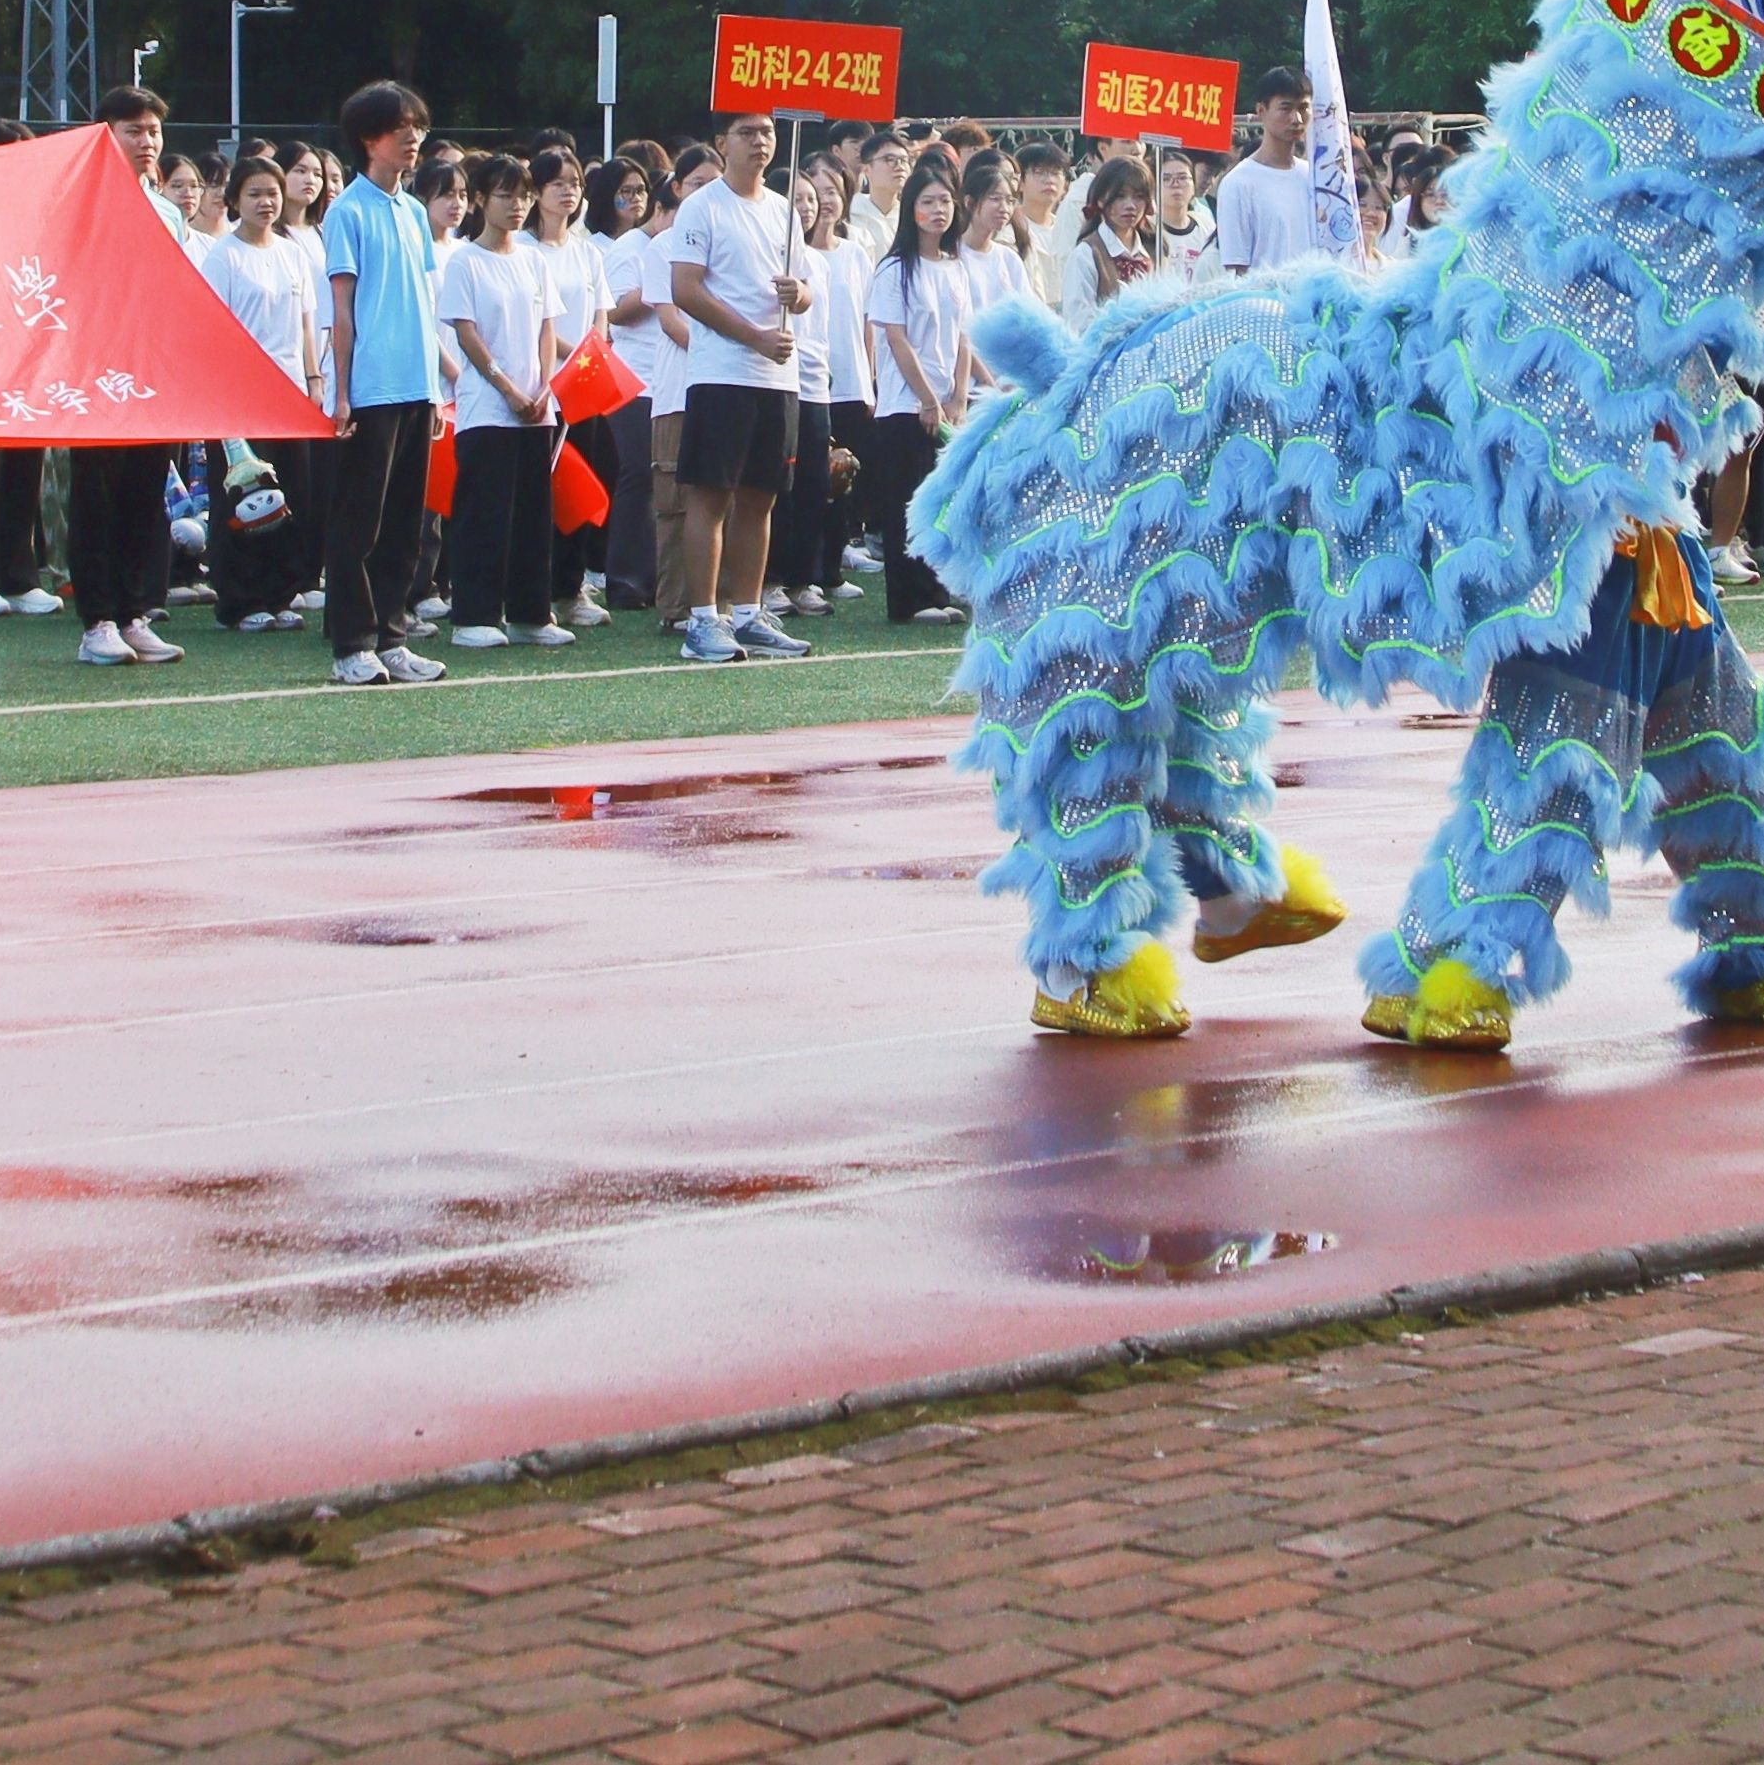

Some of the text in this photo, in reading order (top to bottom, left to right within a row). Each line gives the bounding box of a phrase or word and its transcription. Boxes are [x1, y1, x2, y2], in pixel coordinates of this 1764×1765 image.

[730, 43, 883, 95] 动科242班
[1097, 70, 1222, 126] 动医241班
